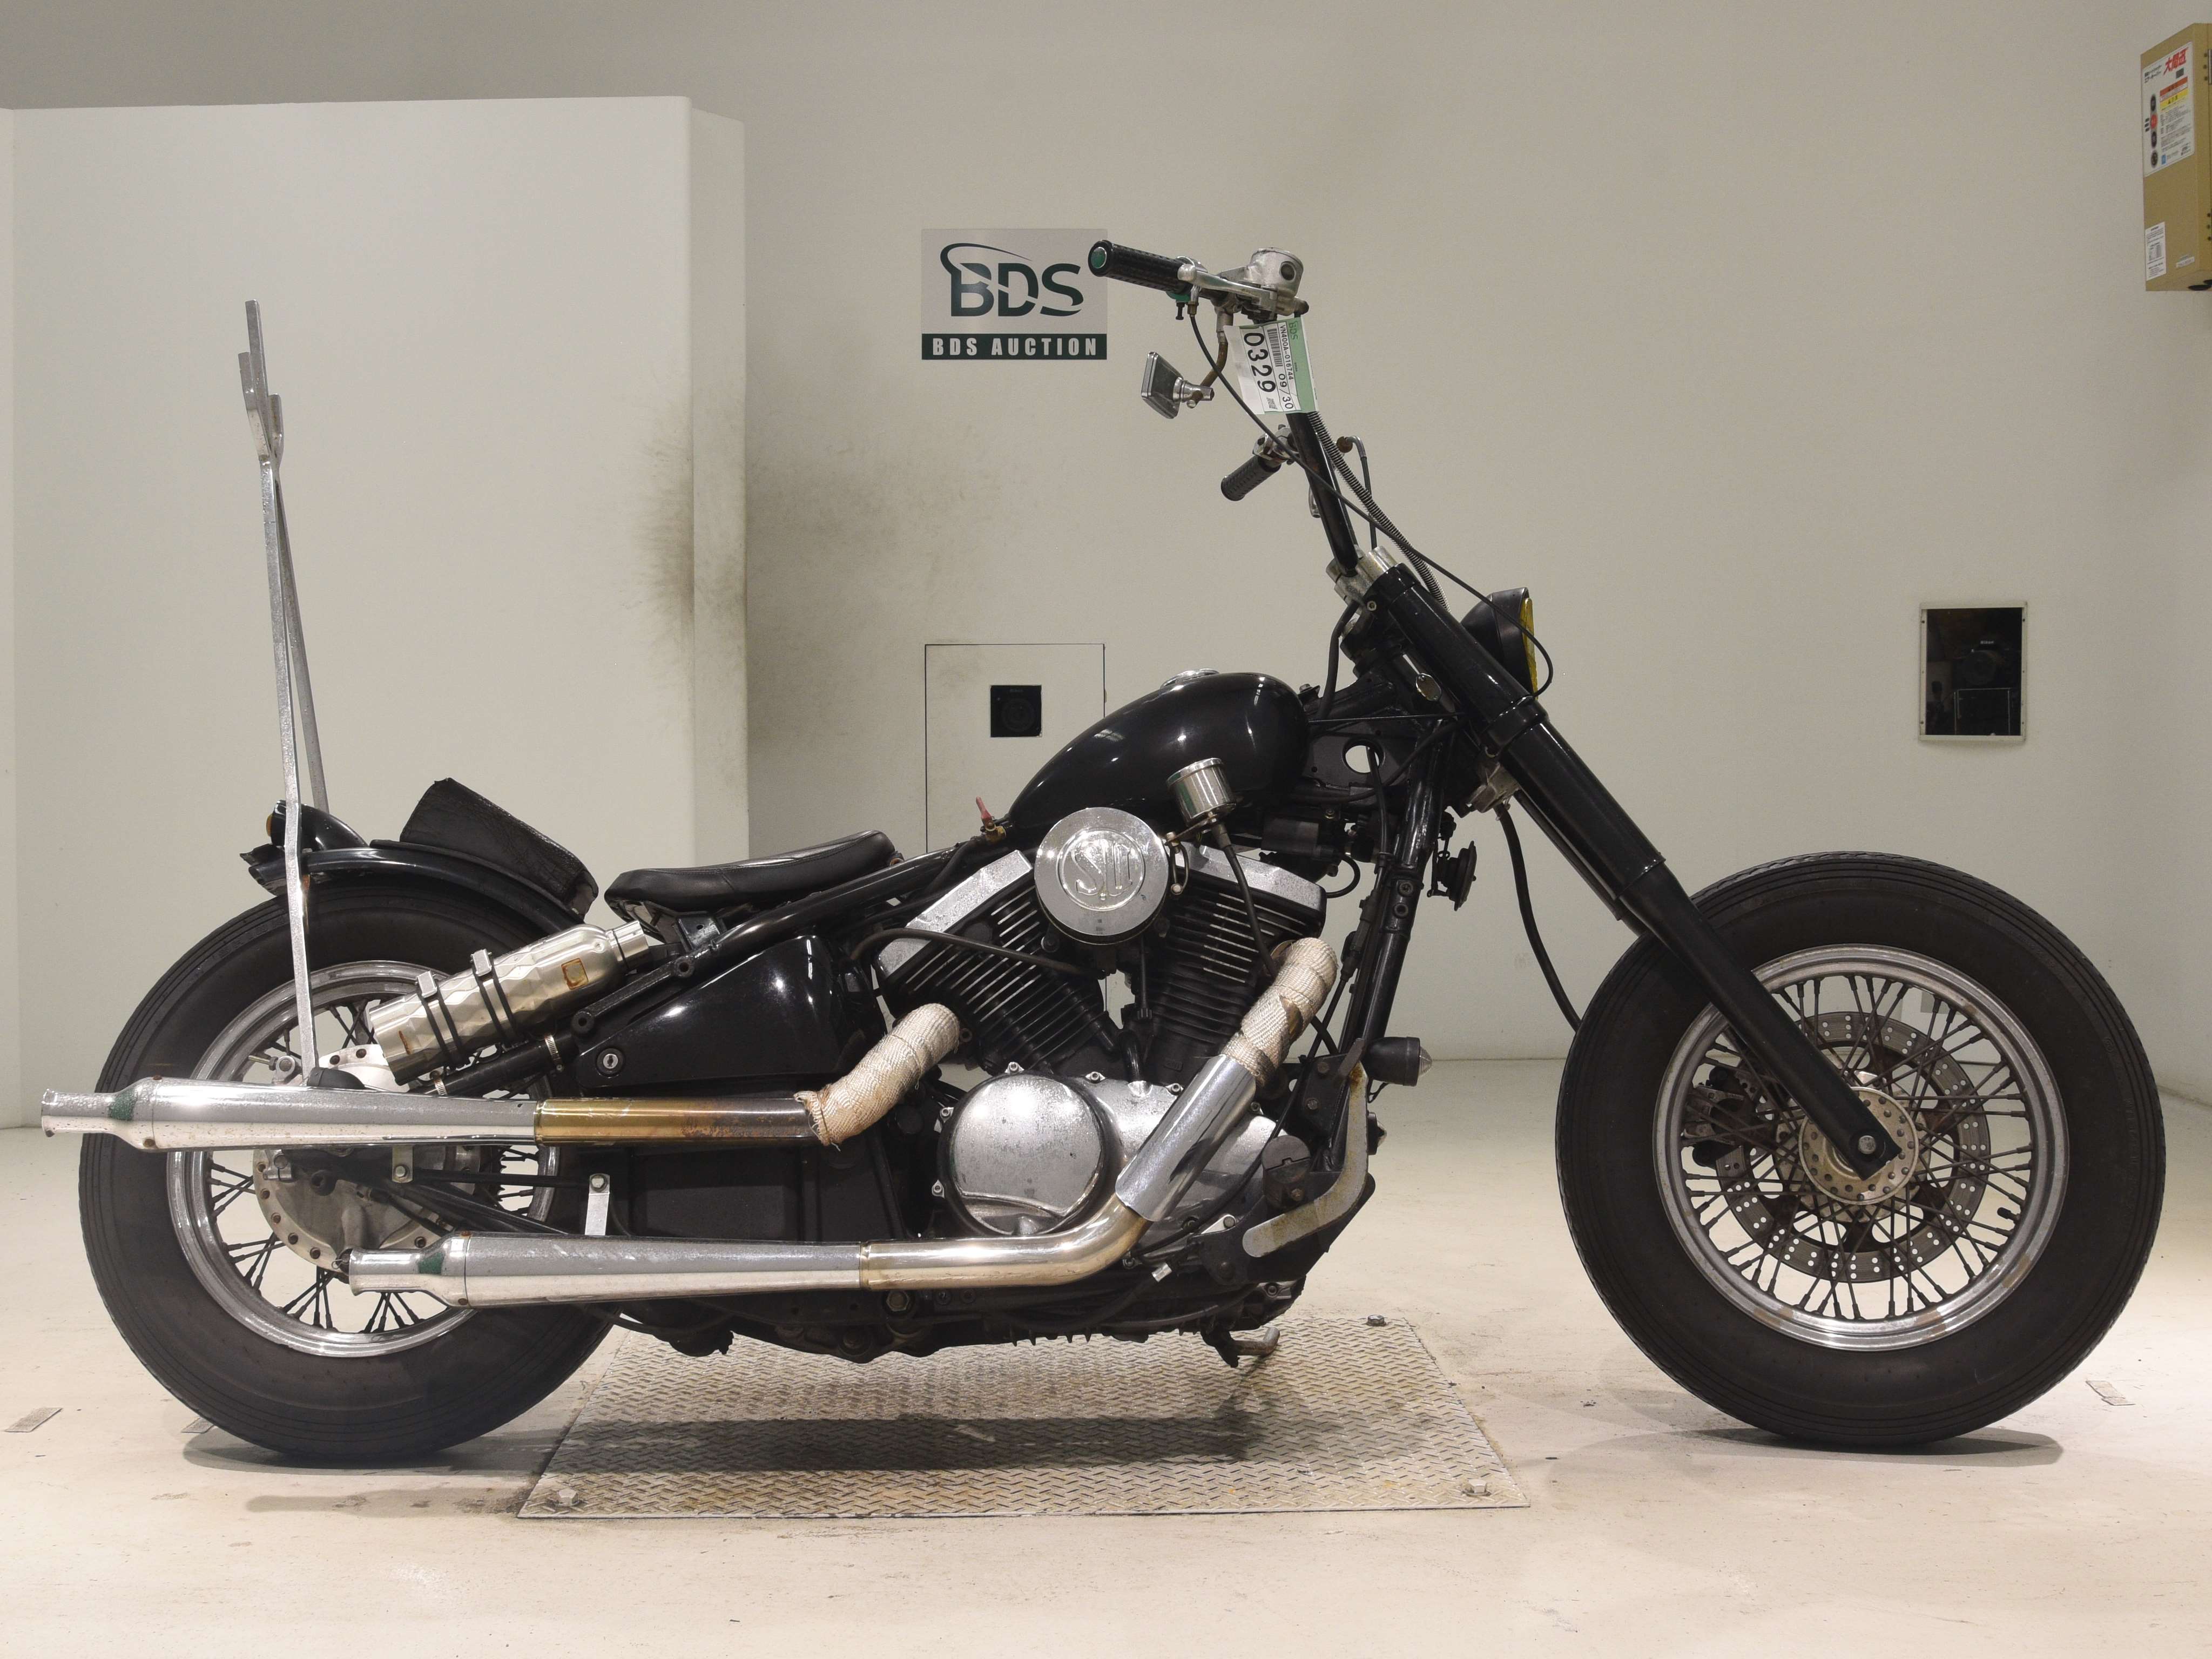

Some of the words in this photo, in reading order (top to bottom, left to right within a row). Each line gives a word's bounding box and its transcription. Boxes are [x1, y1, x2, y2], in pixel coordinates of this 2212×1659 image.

[940, 243, 1083, 316] BDS
[933, 338, 977, 355] BDS
[992, 338, 1096, 355] AUCTION
[1244, 332, 1276, 393] 0329
[1279, 325, 1293, 380] VN400A-016744
[1278, 373, 1294, 409] 09/30
